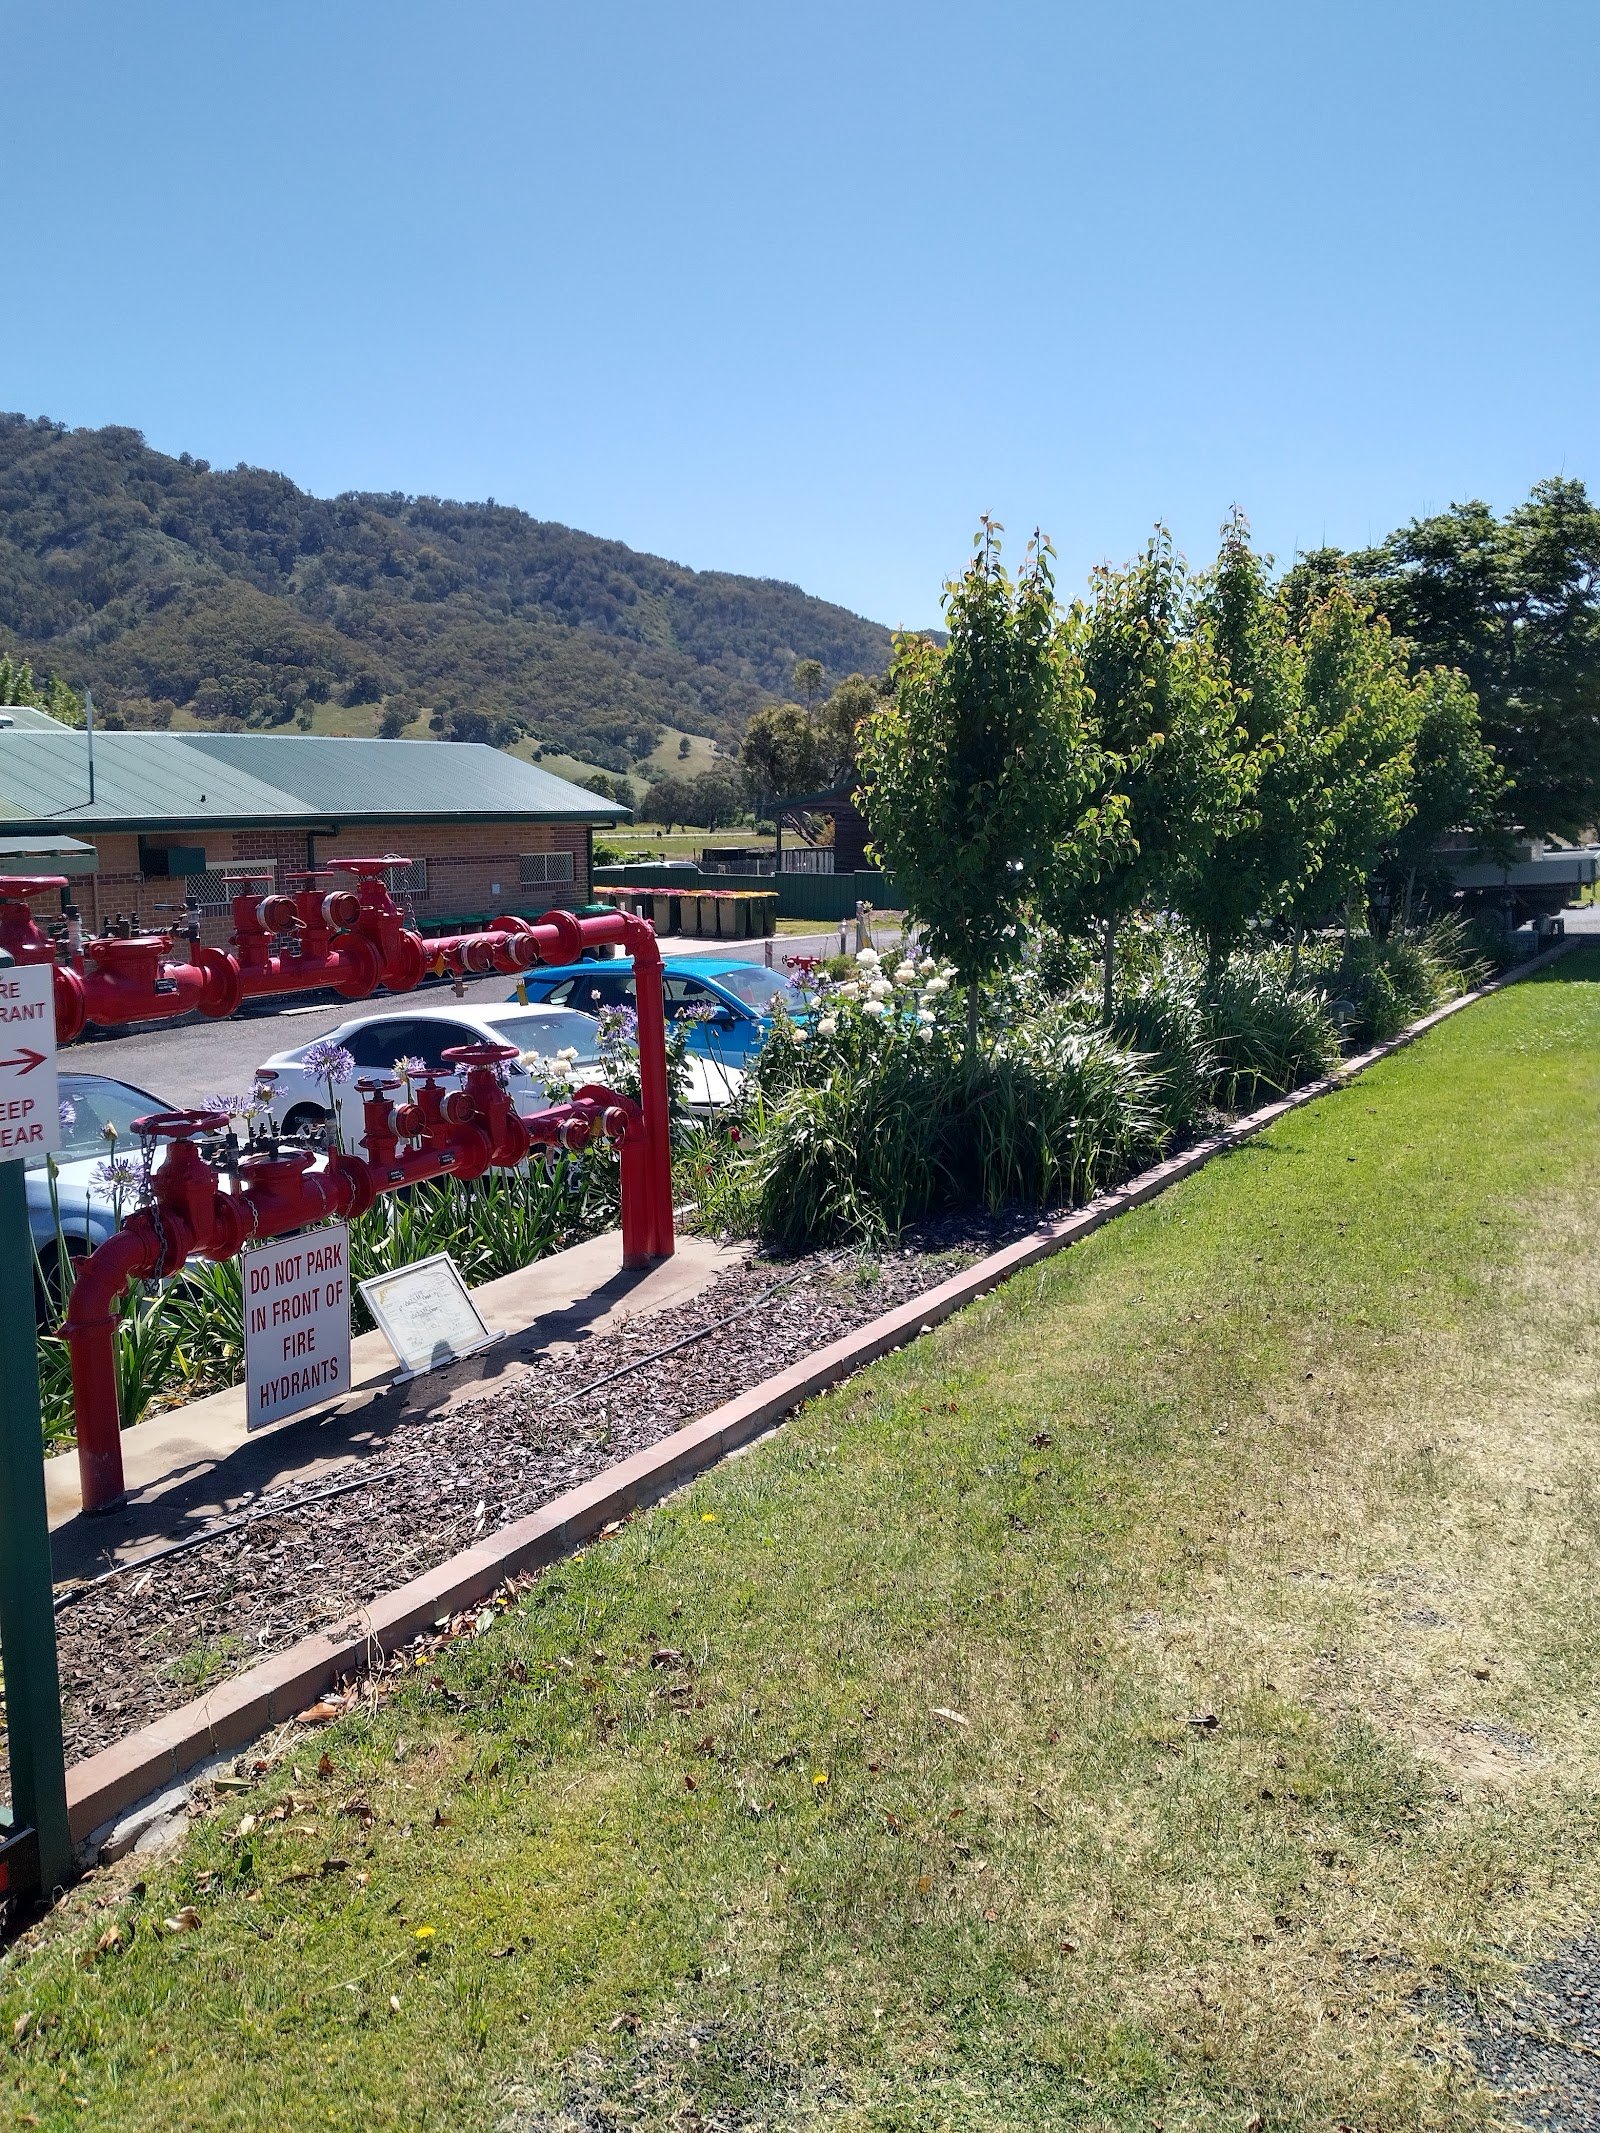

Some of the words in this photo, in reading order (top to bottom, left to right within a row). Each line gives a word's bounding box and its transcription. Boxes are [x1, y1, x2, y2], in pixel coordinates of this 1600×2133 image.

[0, 1002, 46, 1022] RANT
[0, 1124, 44, 1147] EAR
[251, 1266, 270, 1294] DO
[275, 1255, 302, 1287] NOT
[307, 1243, 342, 1276] PARK
[251, 1306, 266, 1334] IN
[273, 1288, 320, 1326] FRONT
[326, 1280, 343, 1307] OF
[283, 1328, 315, 1361] FIRE
[260, 1356, 338, 1409] HYDRANTS
